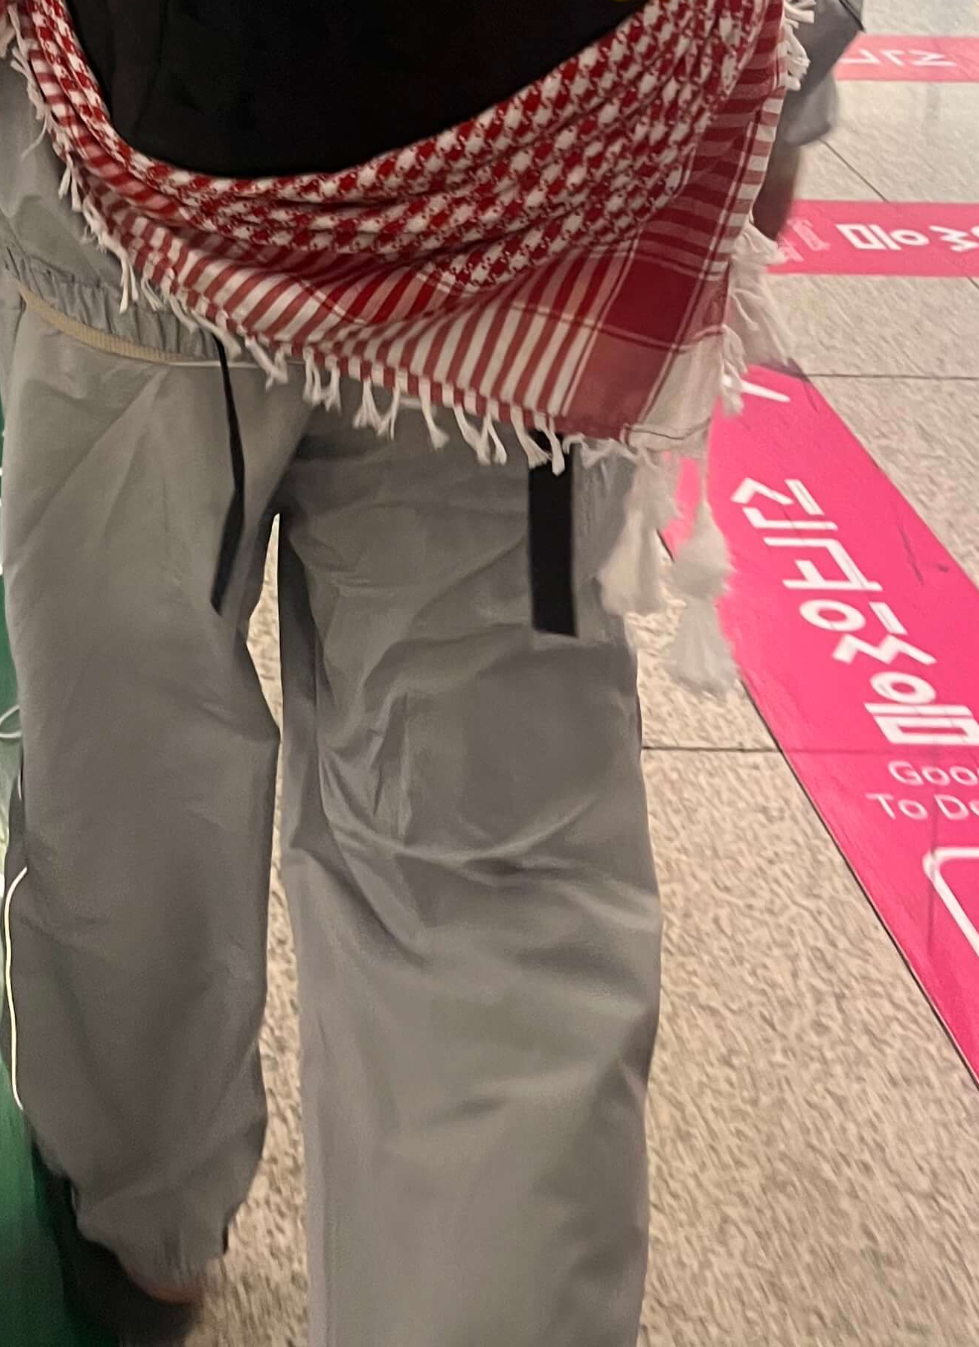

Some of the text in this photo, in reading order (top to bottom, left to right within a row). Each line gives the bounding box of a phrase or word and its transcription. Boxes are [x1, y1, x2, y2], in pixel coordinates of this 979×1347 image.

[730, 477, 979, 745] 신고있음
[888, 760, 979, 786] Goo
[865, 793, 928, 820] To
